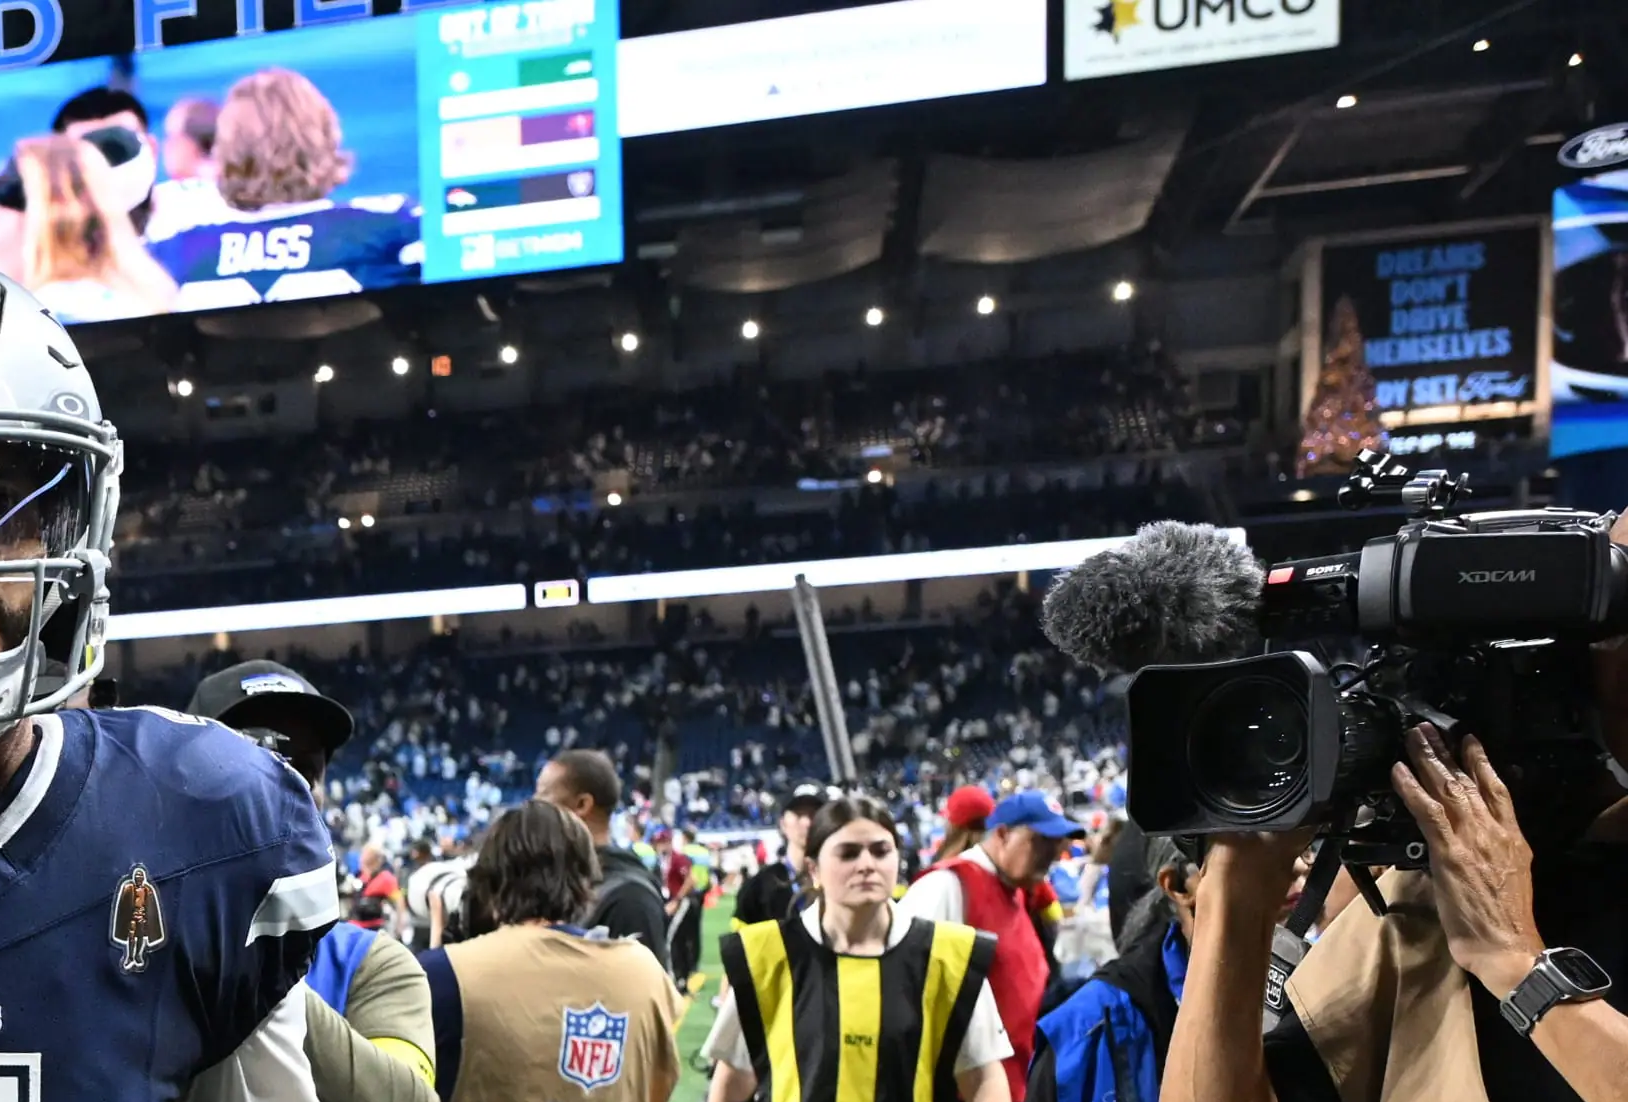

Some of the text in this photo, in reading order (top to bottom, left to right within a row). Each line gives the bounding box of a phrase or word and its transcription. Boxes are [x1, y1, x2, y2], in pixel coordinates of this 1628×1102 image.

[217, 225, 314, 276] BASS
[1365, 327, 1512, 368] HEMSELVES
[1306, 563, 1345, 577] SONY
[1458, 570, 1537, 584] XDCAM
[568, 1039, 615, 1079] NFL
